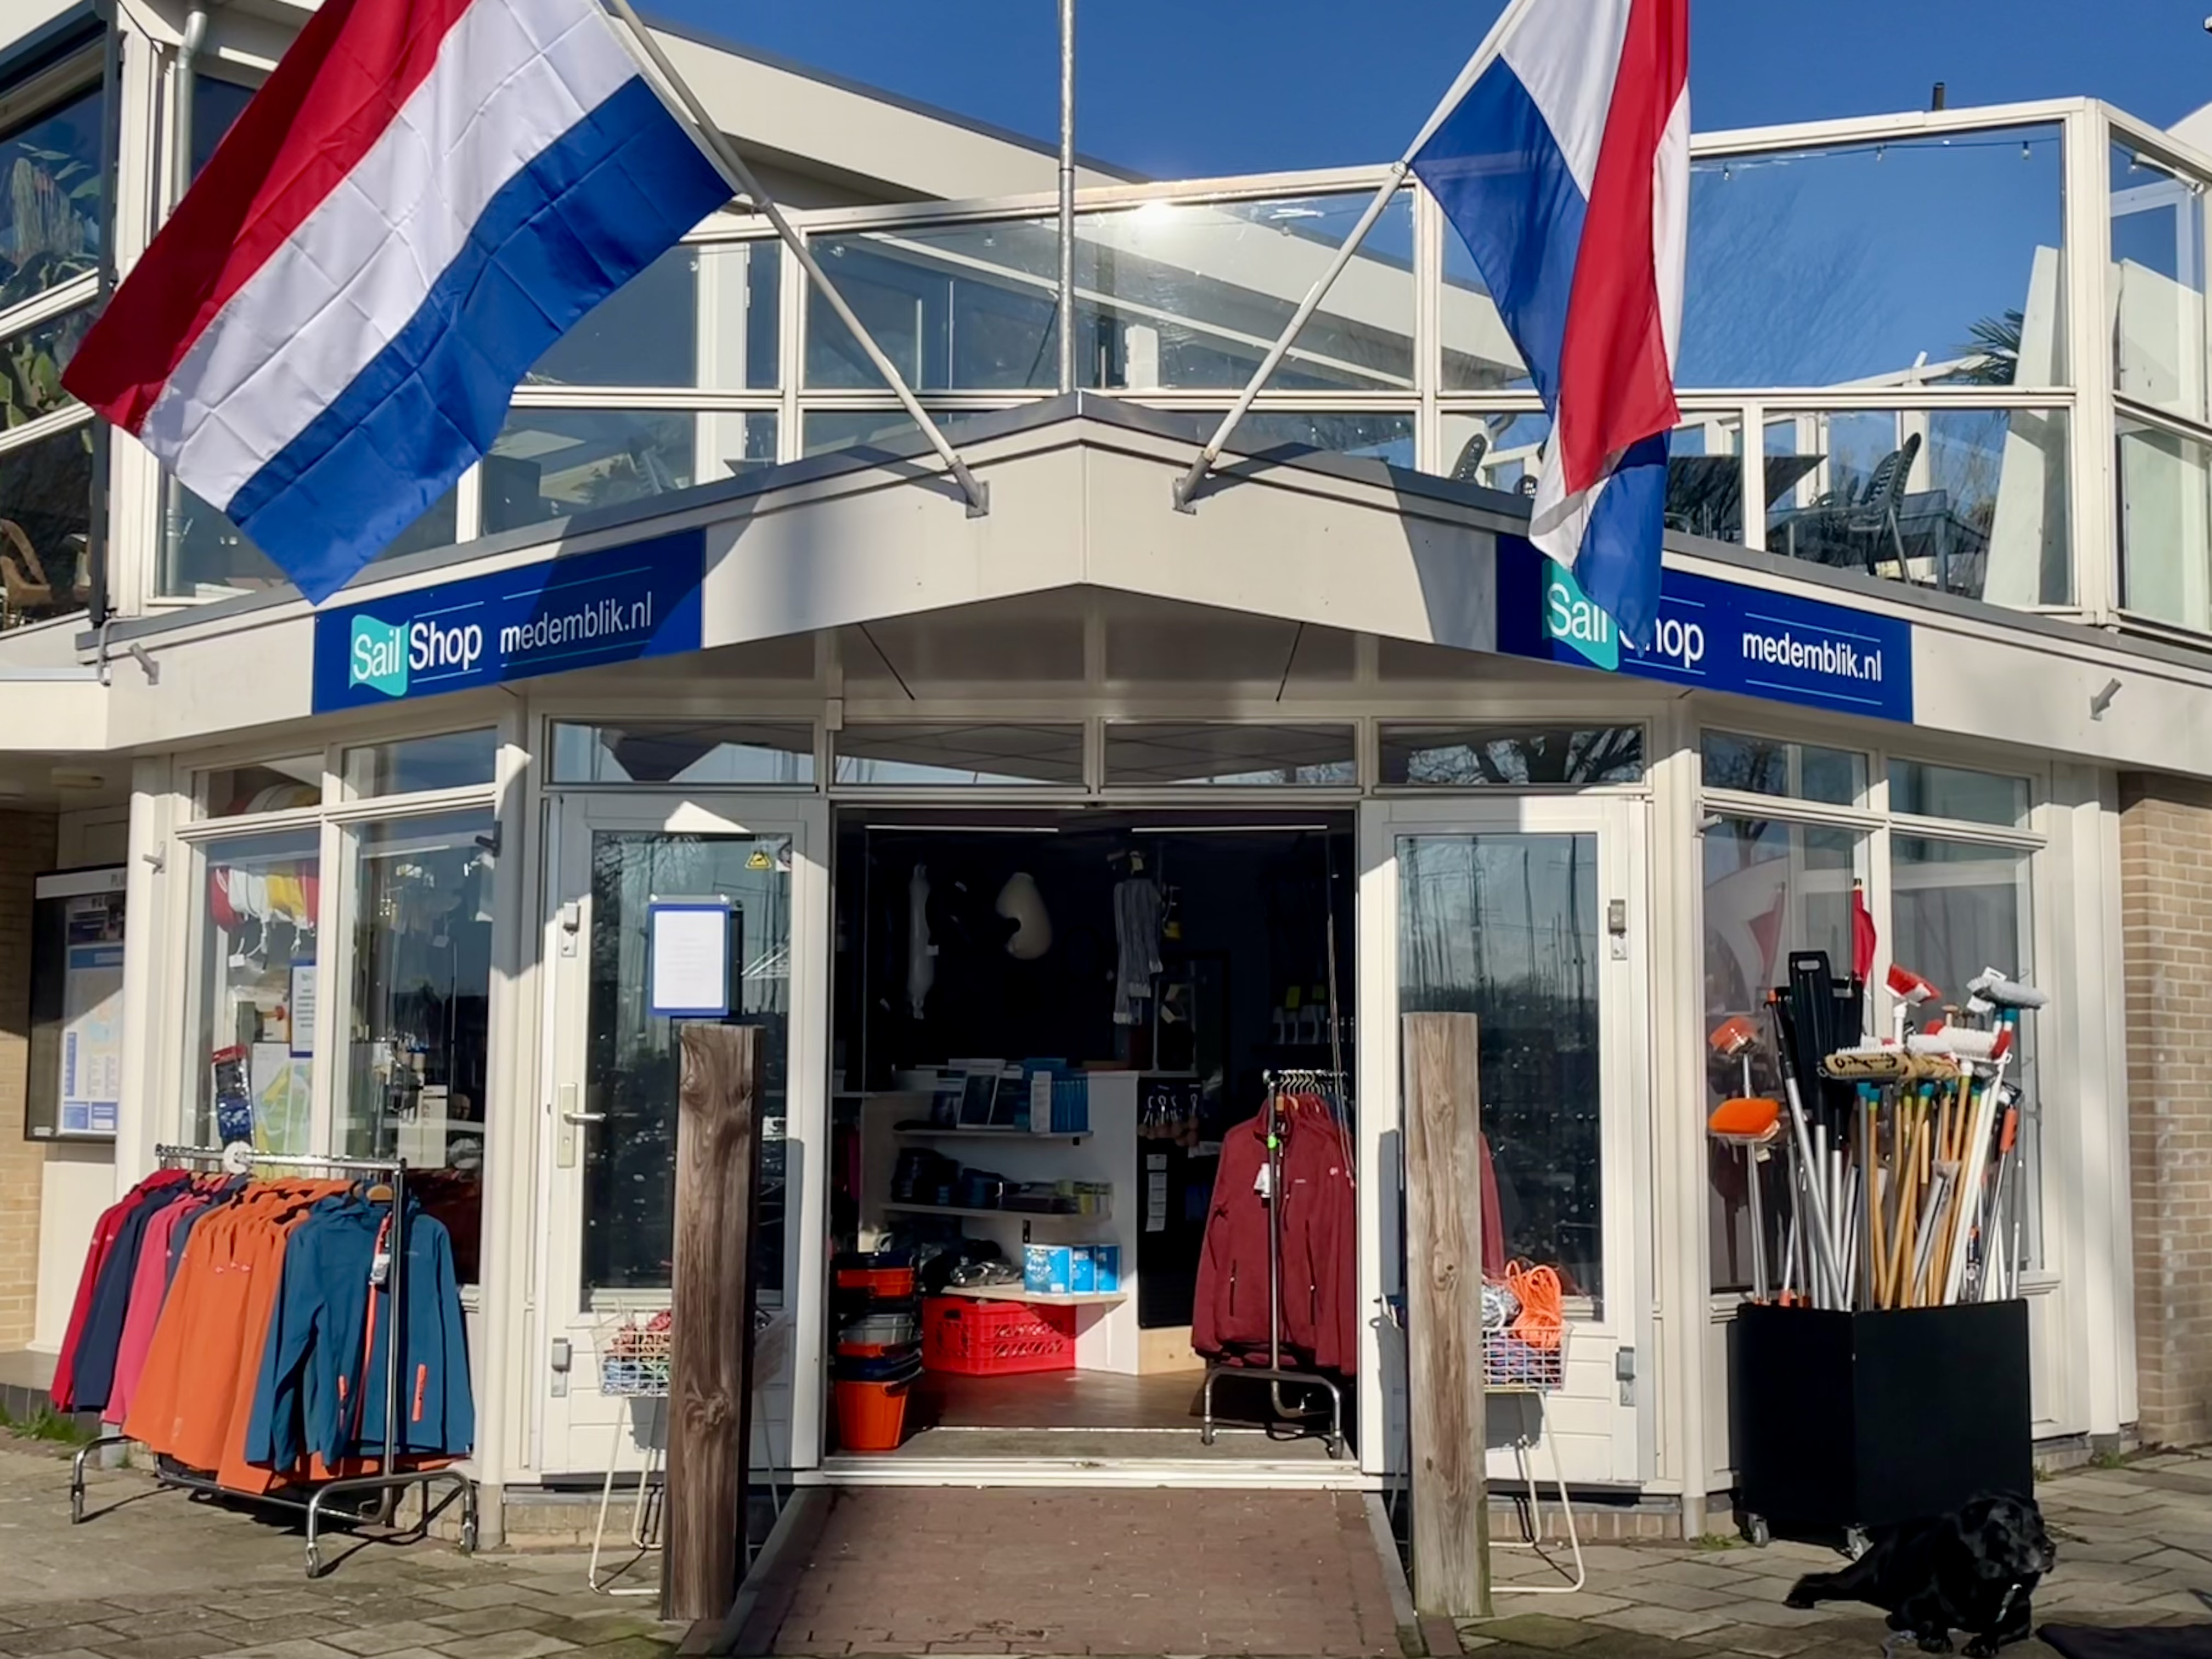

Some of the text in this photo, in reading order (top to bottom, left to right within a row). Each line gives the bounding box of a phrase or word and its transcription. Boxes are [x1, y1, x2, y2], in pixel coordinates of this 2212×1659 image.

[353, 590, 652, 680] Sail Shop medemblik.nl
[1546, 582, 1607, 644] Sail
[1742, 631, 1882, 682] medemblik.nl
